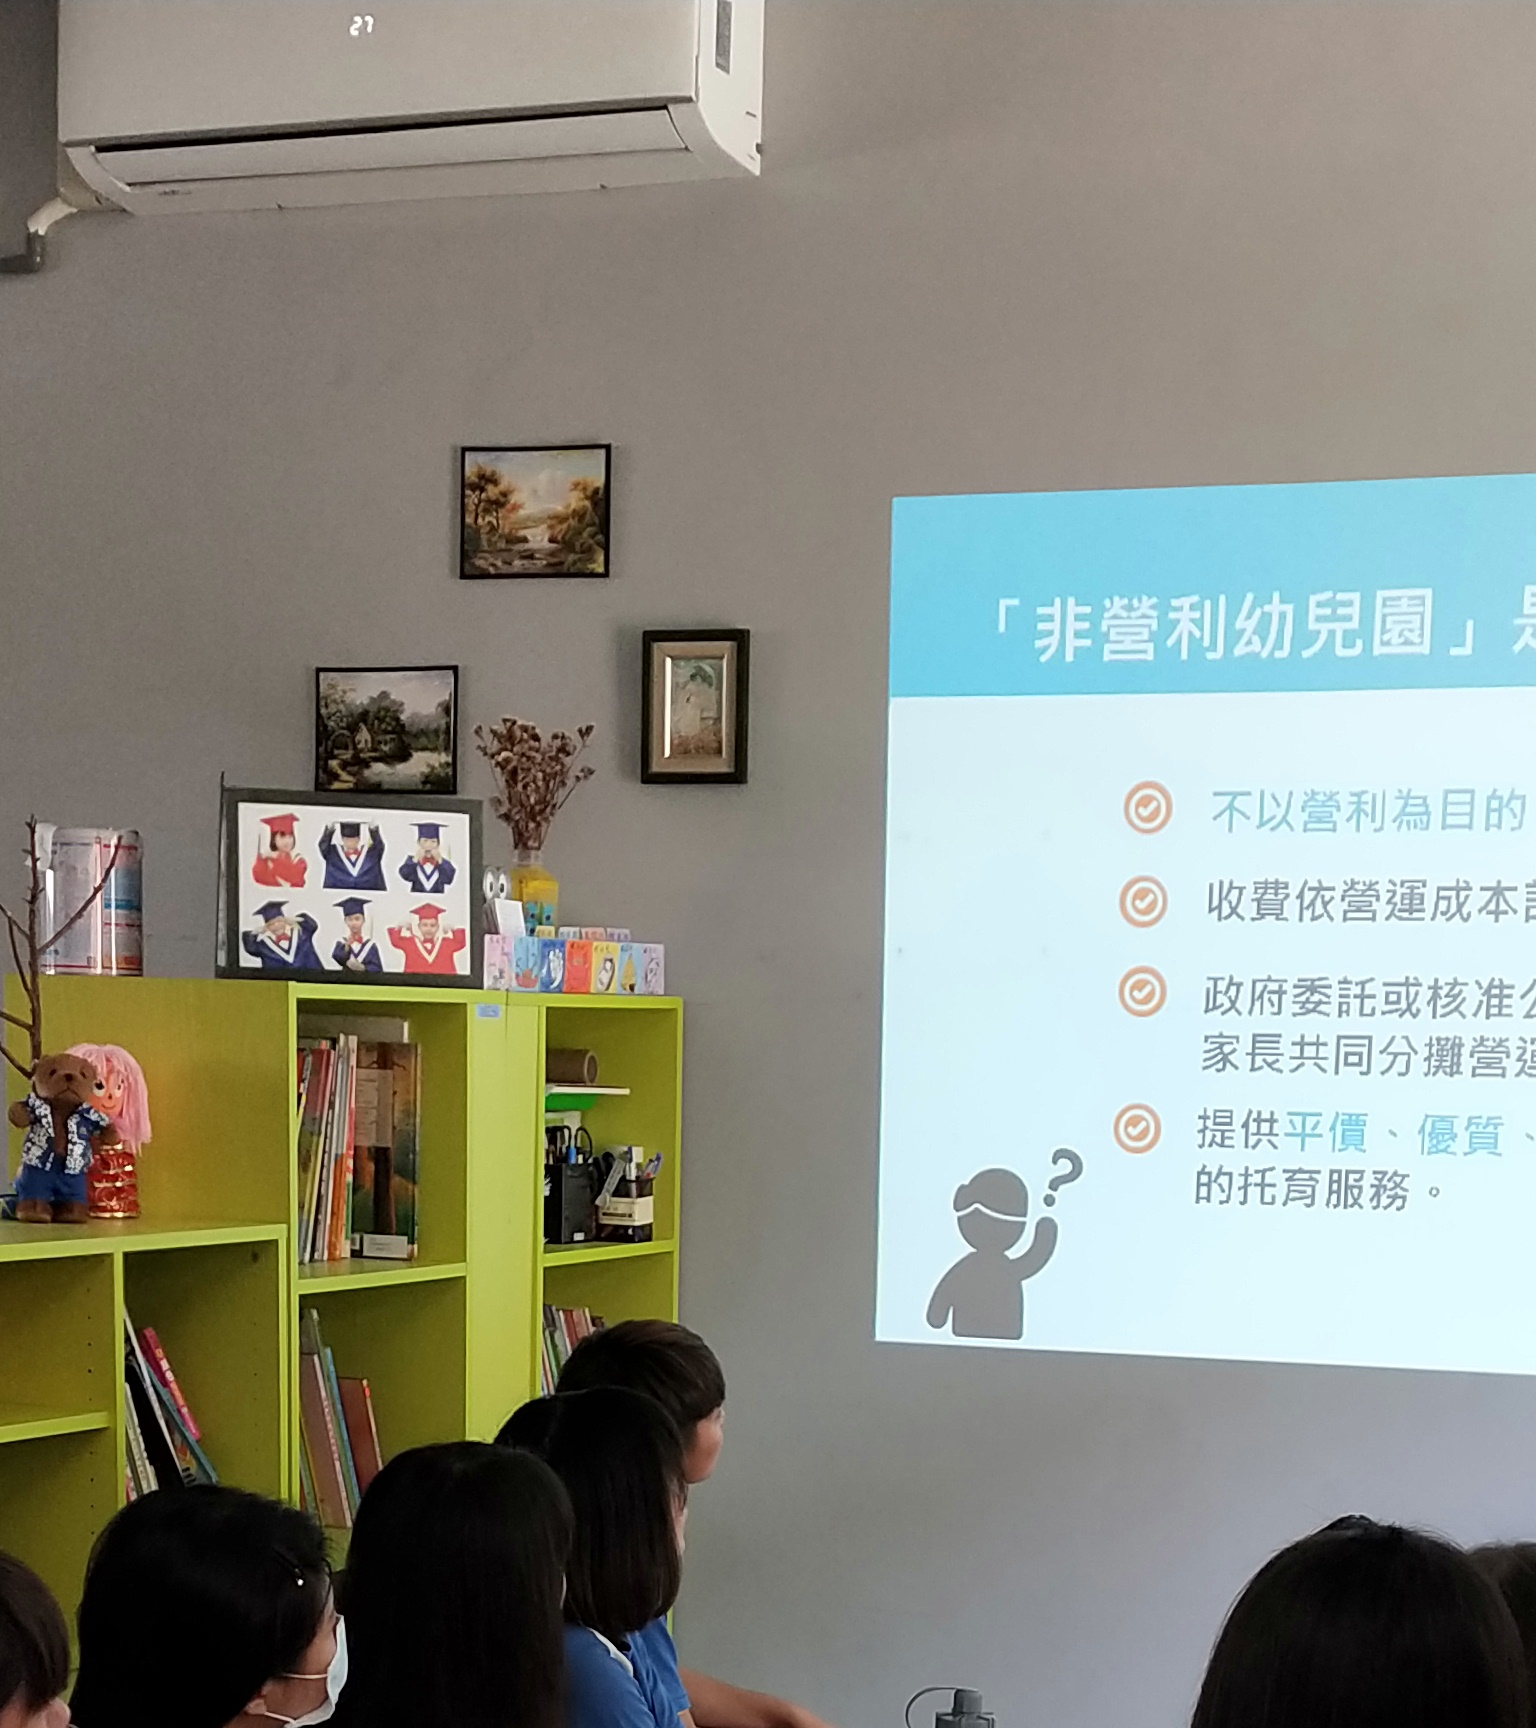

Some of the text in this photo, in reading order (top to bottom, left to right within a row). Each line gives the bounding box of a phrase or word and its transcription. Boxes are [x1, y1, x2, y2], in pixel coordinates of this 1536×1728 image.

[350, 15, 374, 36] 27
[1194, 1164, 1441, 1211] 的托育服務。
